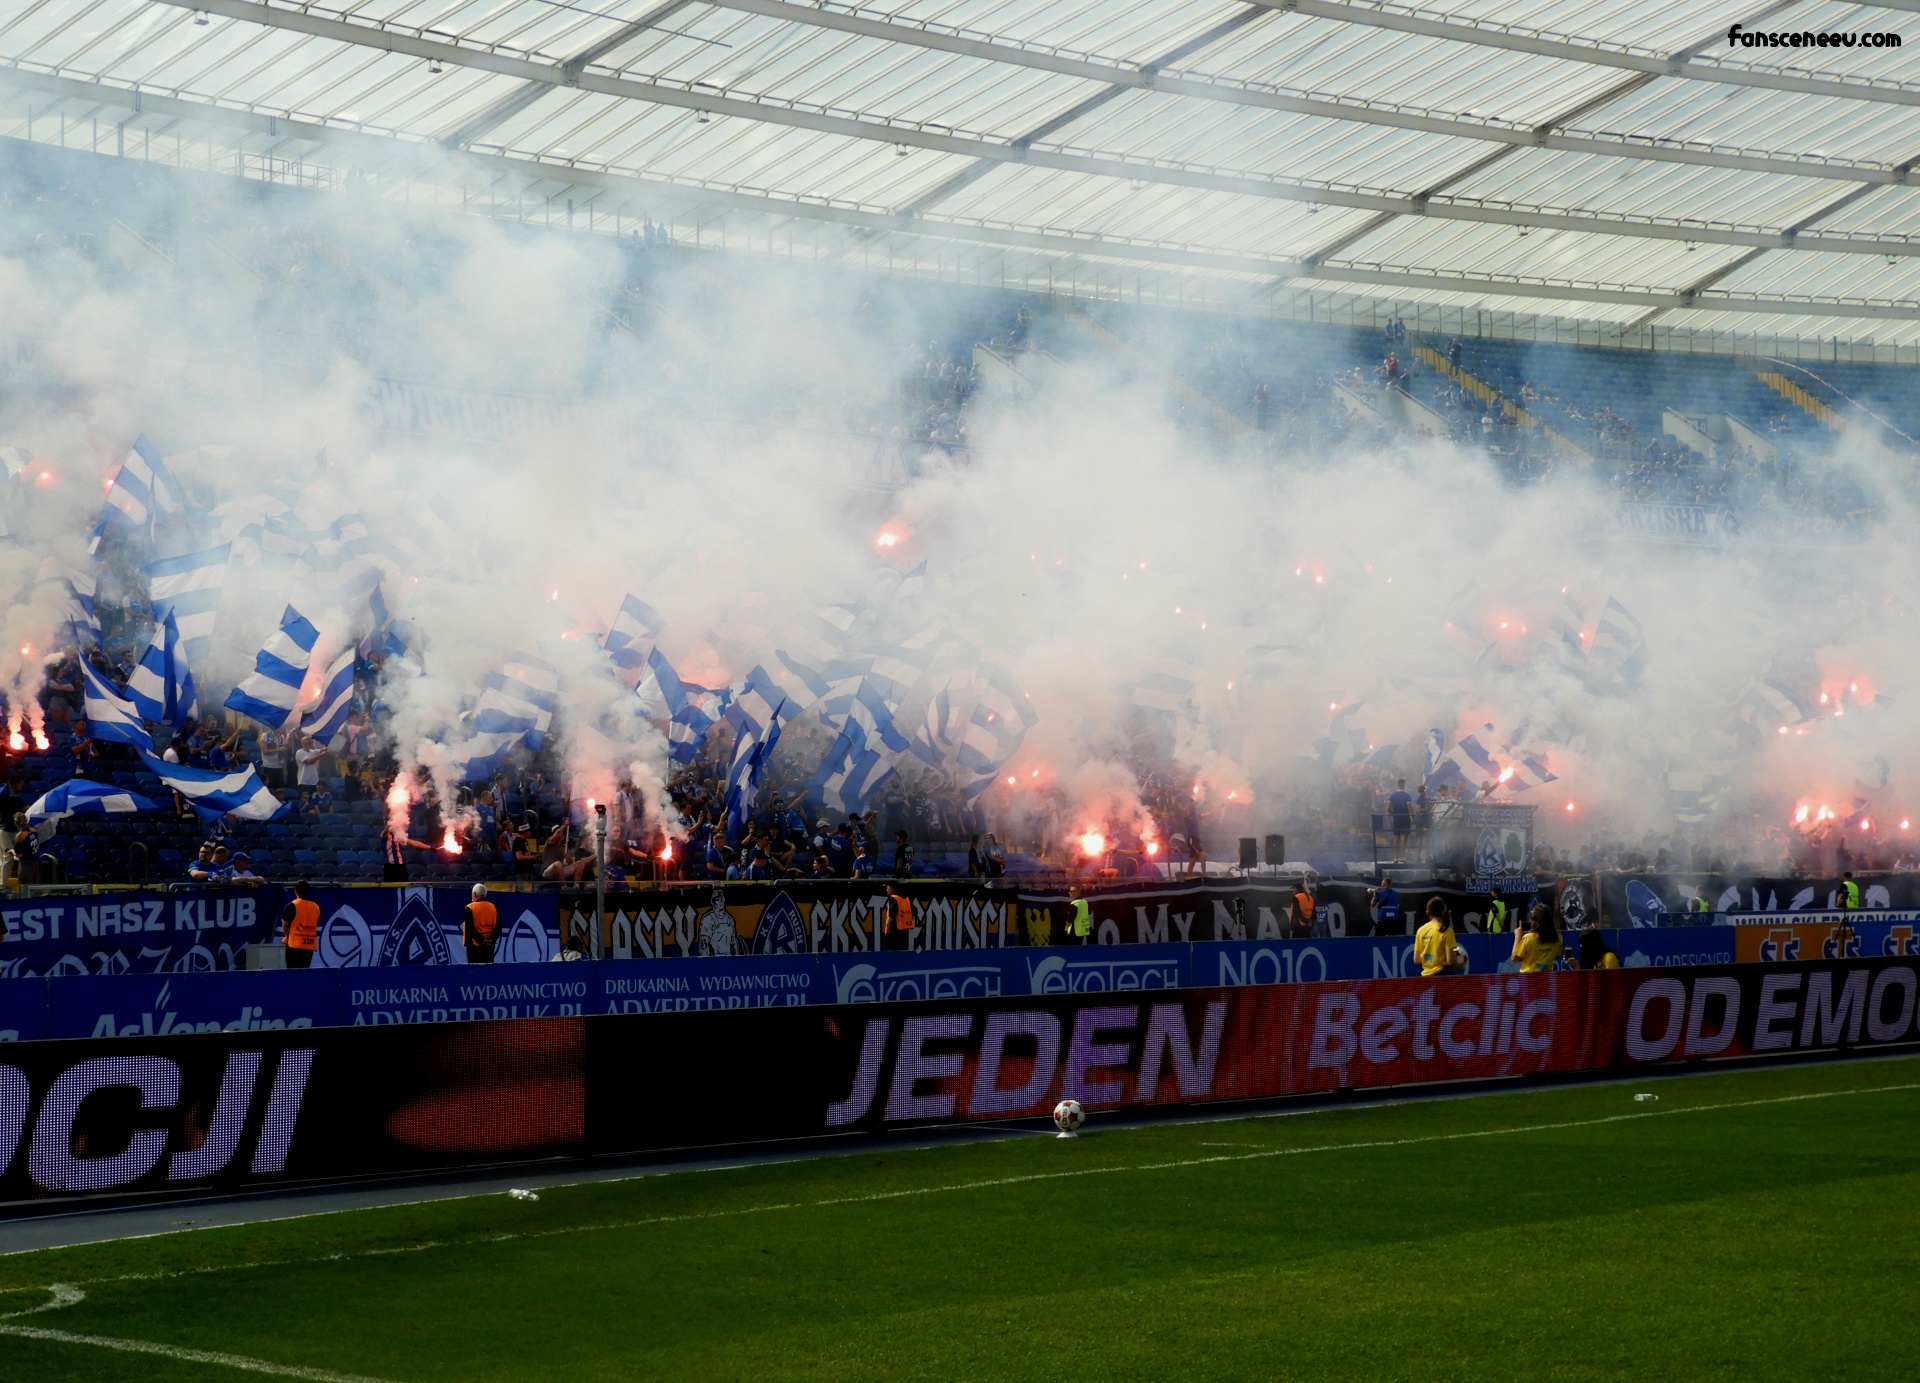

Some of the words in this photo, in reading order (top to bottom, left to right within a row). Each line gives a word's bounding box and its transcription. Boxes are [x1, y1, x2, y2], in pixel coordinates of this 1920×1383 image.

[76, 900, 165, 938] NASZ
[175, 897, 257, 931] KLUB
[426, 920, 448, 963] RUCH
[789, 909, 803, 945] RUCH
[811, 889, 1007, 955] EKSTEMIŚCI
[352, 987, 449, 1006] DRUKARNIA
[460, 981, 587, 1001] WYDAWNICTWO
[605, 977, 690, 994] DRUKARNIA
[699, 973, 810, 991] WYDAWNICTWO
[1308, 977, 1557, 1070] Betclic
[1626, 976, 1741, 1060] OD
[1753, 966, 1920, 1050] EMO
[825, 999, 1227, 1126] JEDEN
[0, 1048, 316, 1192] CJI
